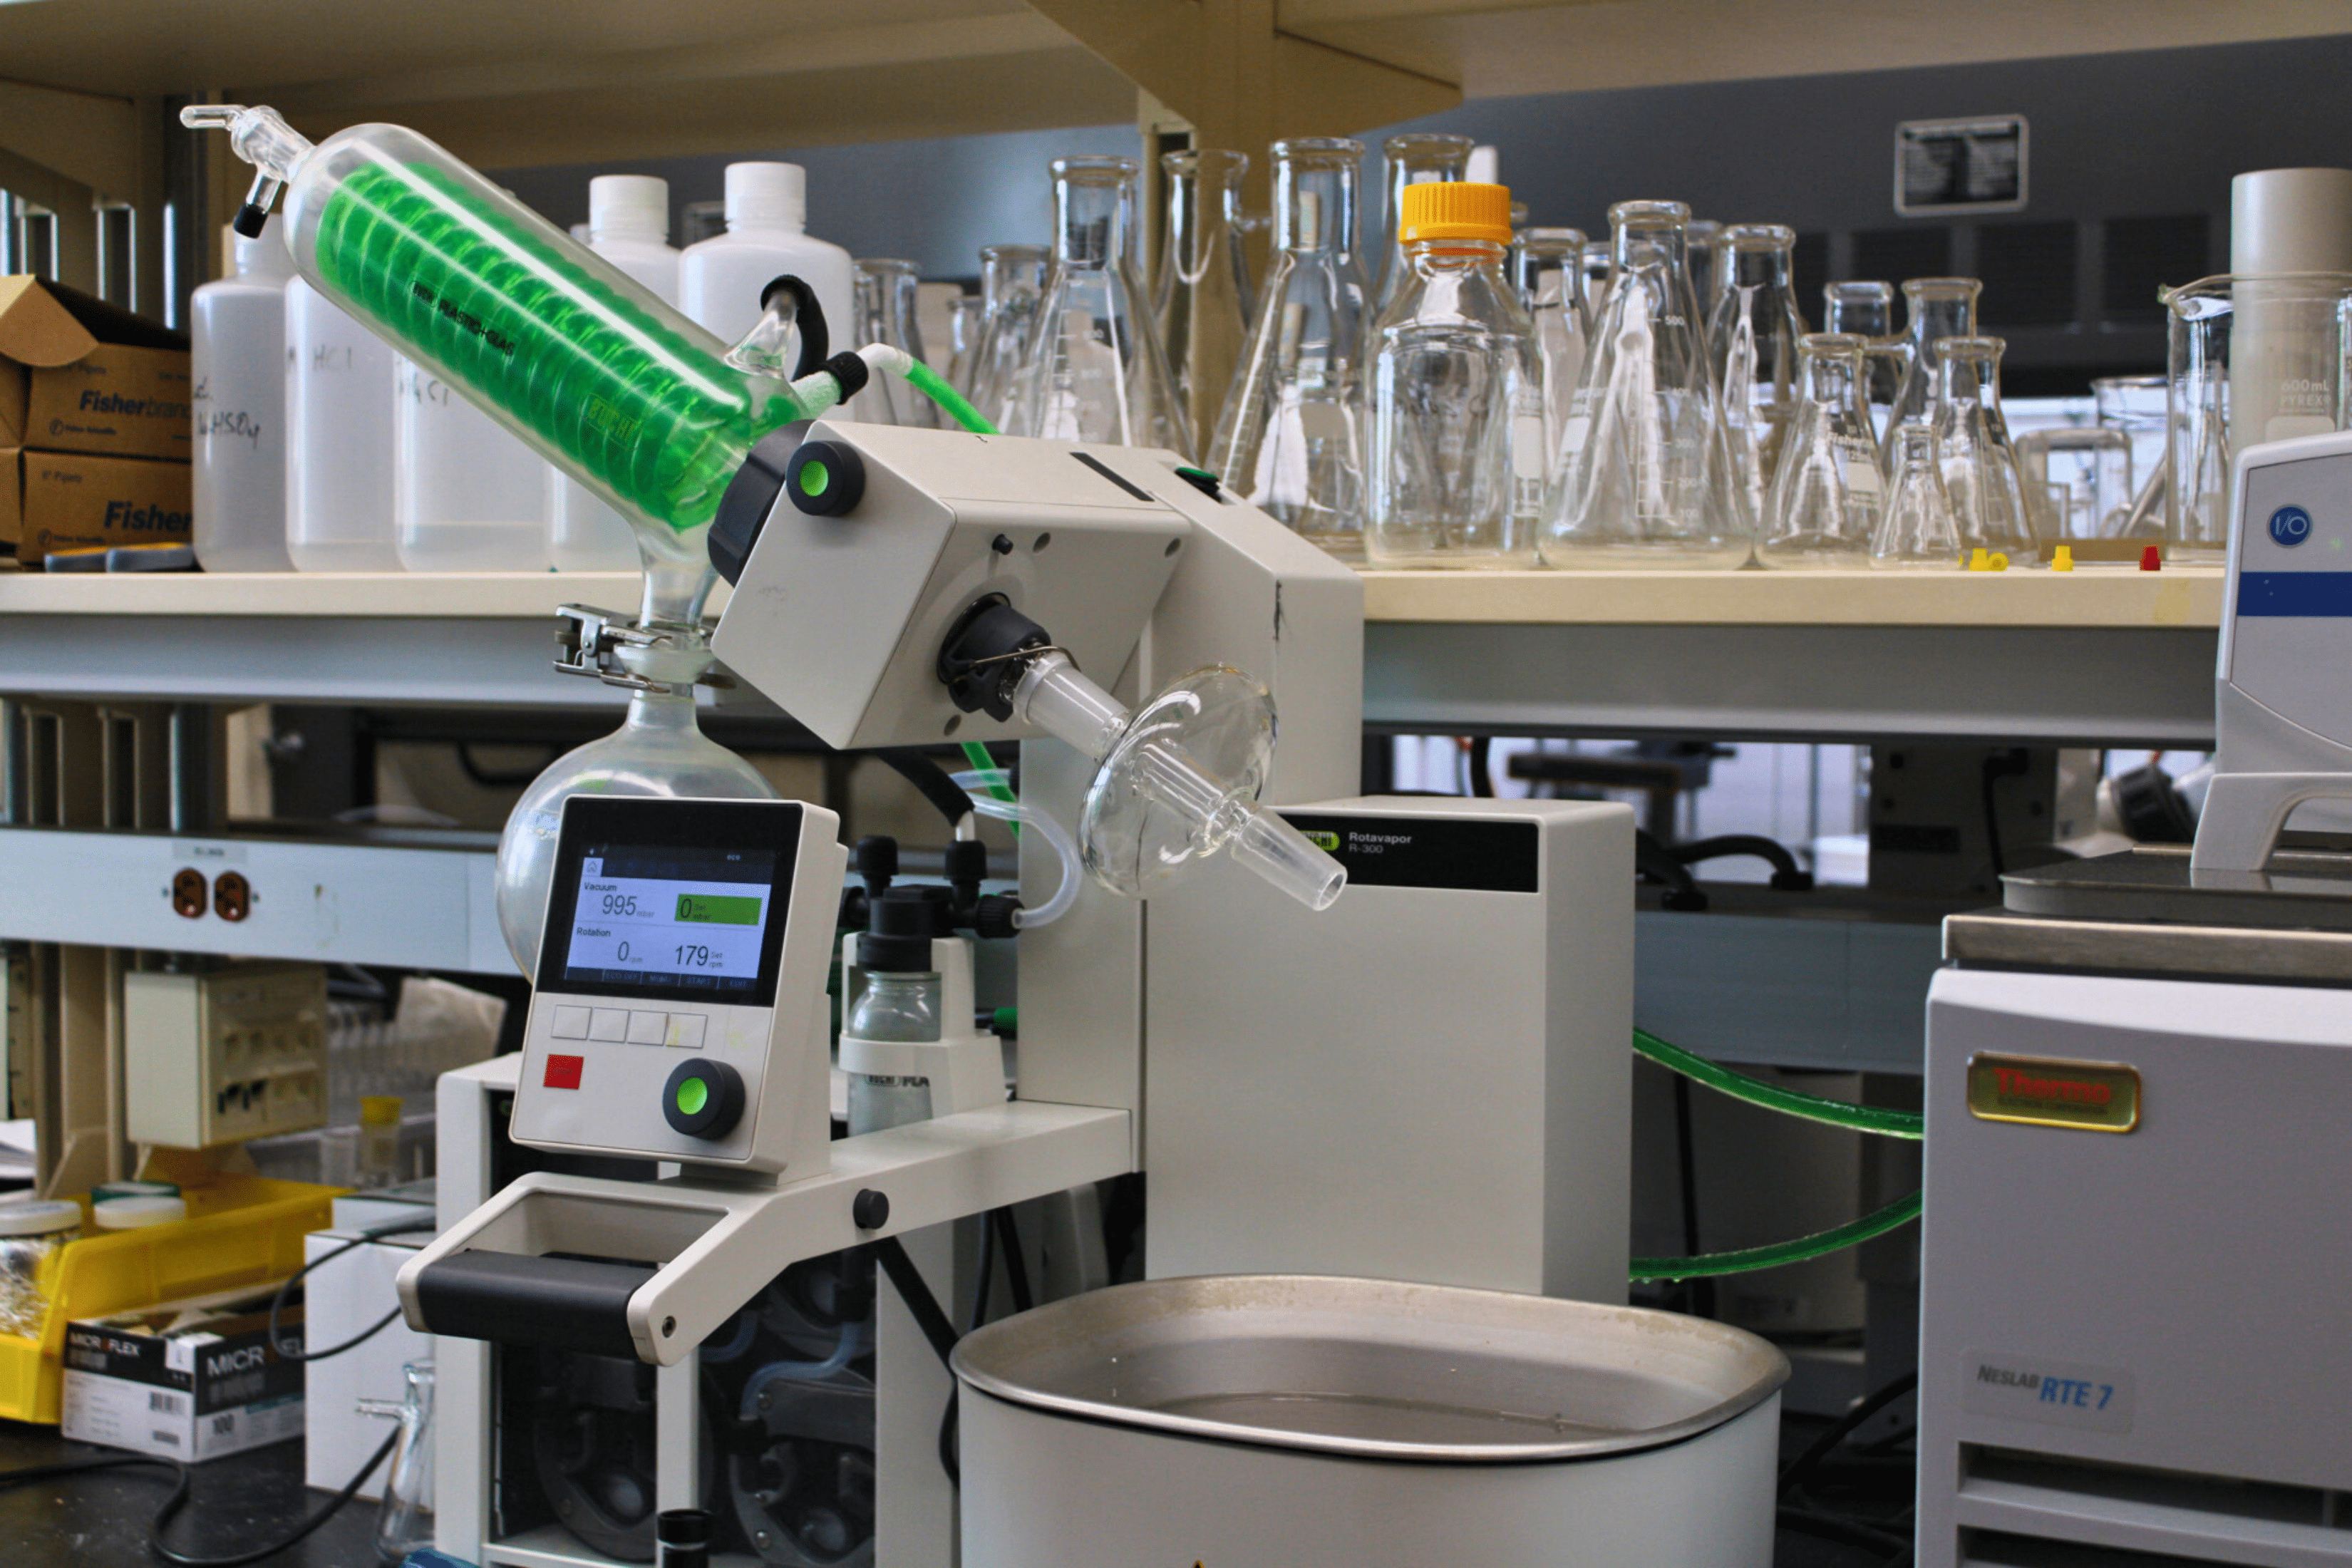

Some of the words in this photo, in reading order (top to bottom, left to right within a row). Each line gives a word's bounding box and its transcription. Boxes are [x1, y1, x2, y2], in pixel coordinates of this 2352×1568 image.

[1348, 831, 1412, 845] Rotavapor
[1348, 843, 1383, 854] R-300
[584, 882, 617, 892] Vacuum
[602, 894, 637, 916] 995
[680, 897, 693, 919] 0
[576, 927, 611, 937] Rotation
[617, 940, 630, 962] 0
[675, 944, 709, 966] 179
[1977, 1364, 2041, 1389] NESLAB
[2039, 1376, 2093, 1409] RTE
[2097, 1384, 2115, 1410] 7
